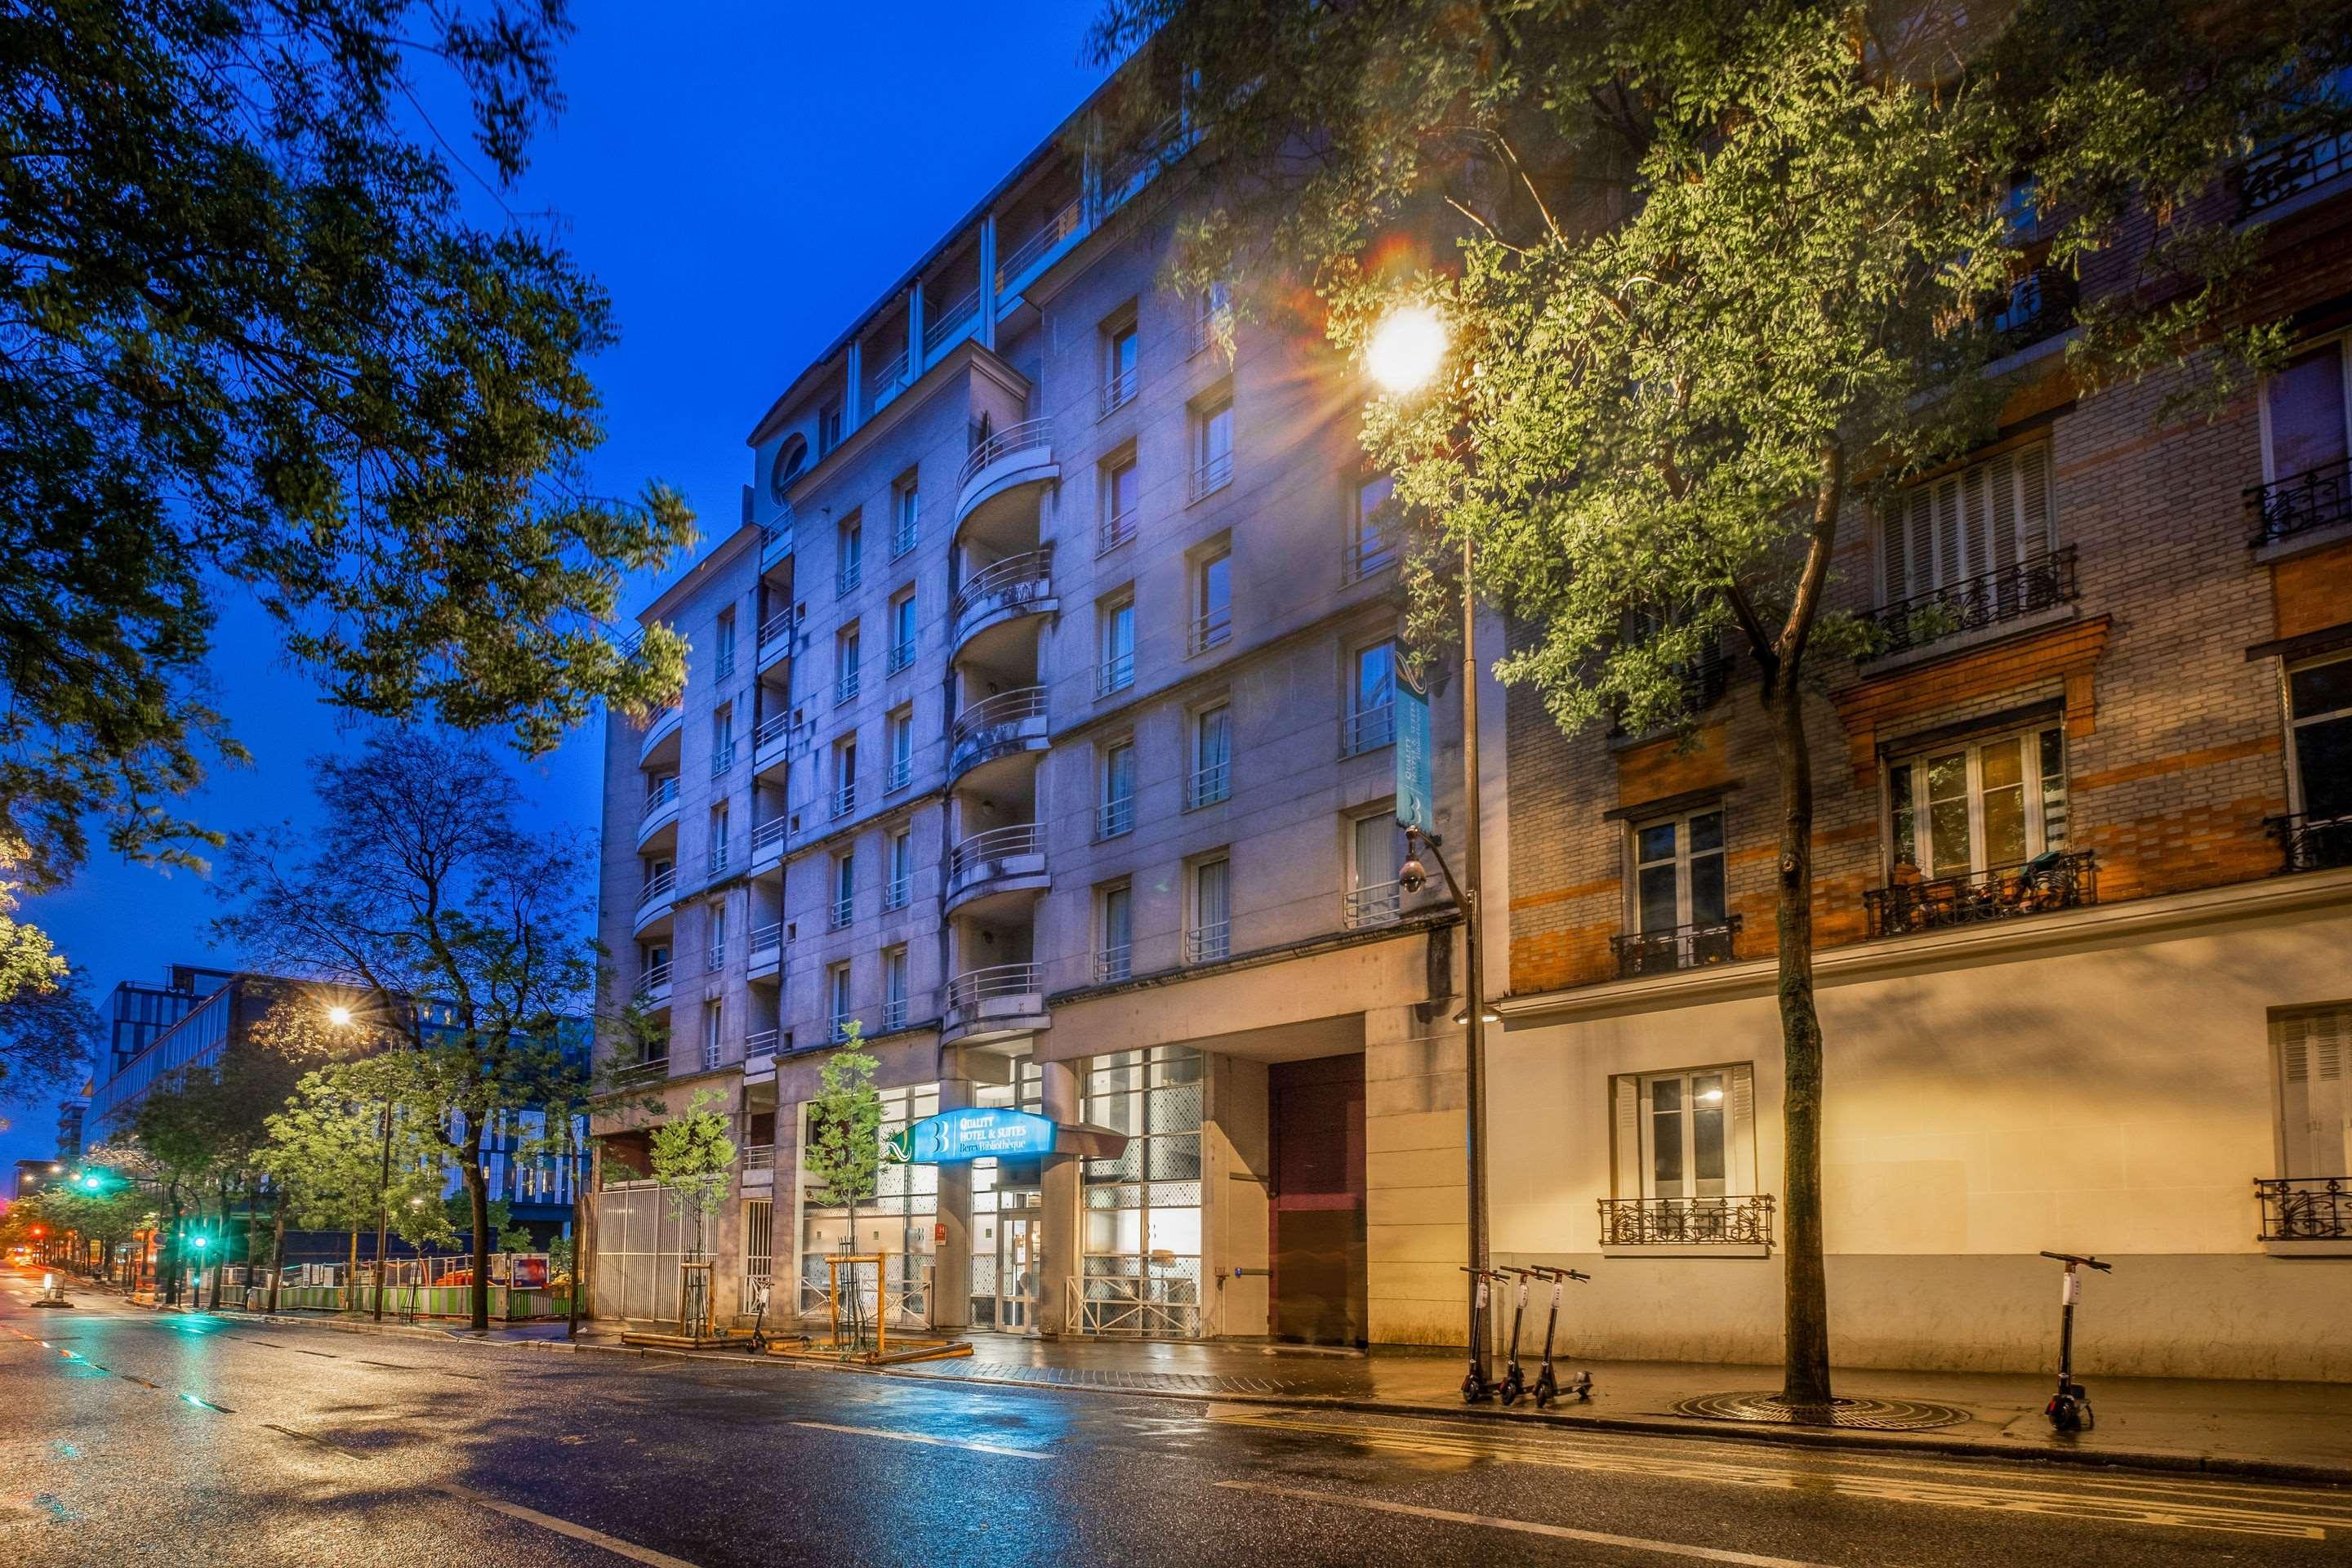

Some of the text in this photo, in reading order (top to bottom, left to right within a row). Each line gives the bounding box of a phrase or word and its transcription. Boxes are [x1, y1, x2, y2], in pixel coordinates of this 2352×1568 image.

[960, 1116, 994, 1129] QUALITY
[960, 1125, 1026, 1142] HOTEL & SUITES
